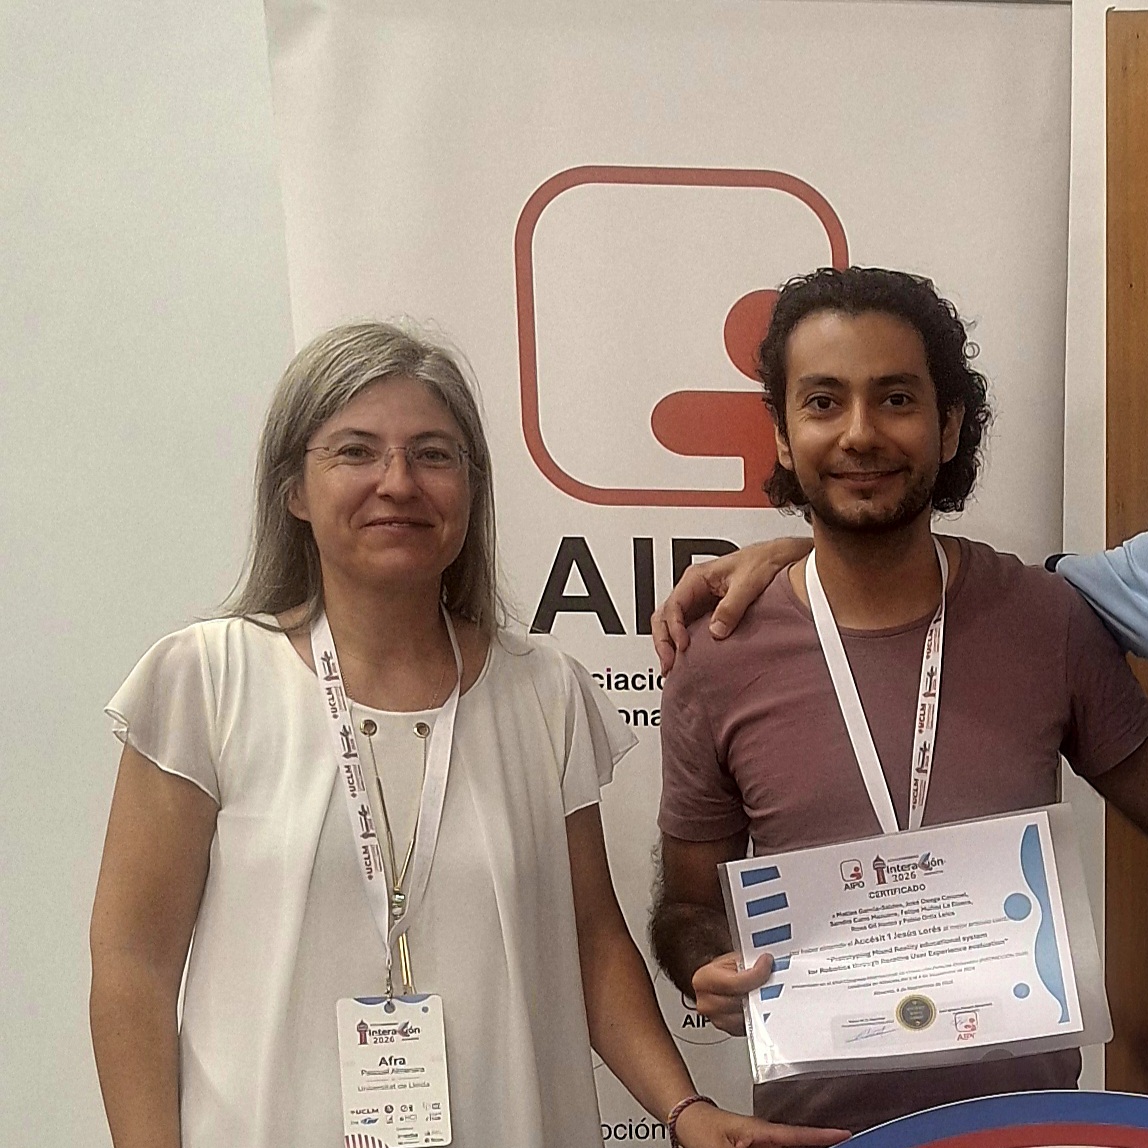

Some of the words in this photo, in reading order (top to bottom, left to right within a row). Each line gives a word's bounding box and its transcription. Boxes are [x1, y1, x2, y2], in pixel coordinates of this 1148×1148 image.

[344, 765, 357, 792] UCLM
[362, 846, 374, 874] UCLM
[891, 871, 917, 883] 2026
[868, 883, 927, 899] CERTIFICADO
[379, 1055, 406, 1067] Afra
